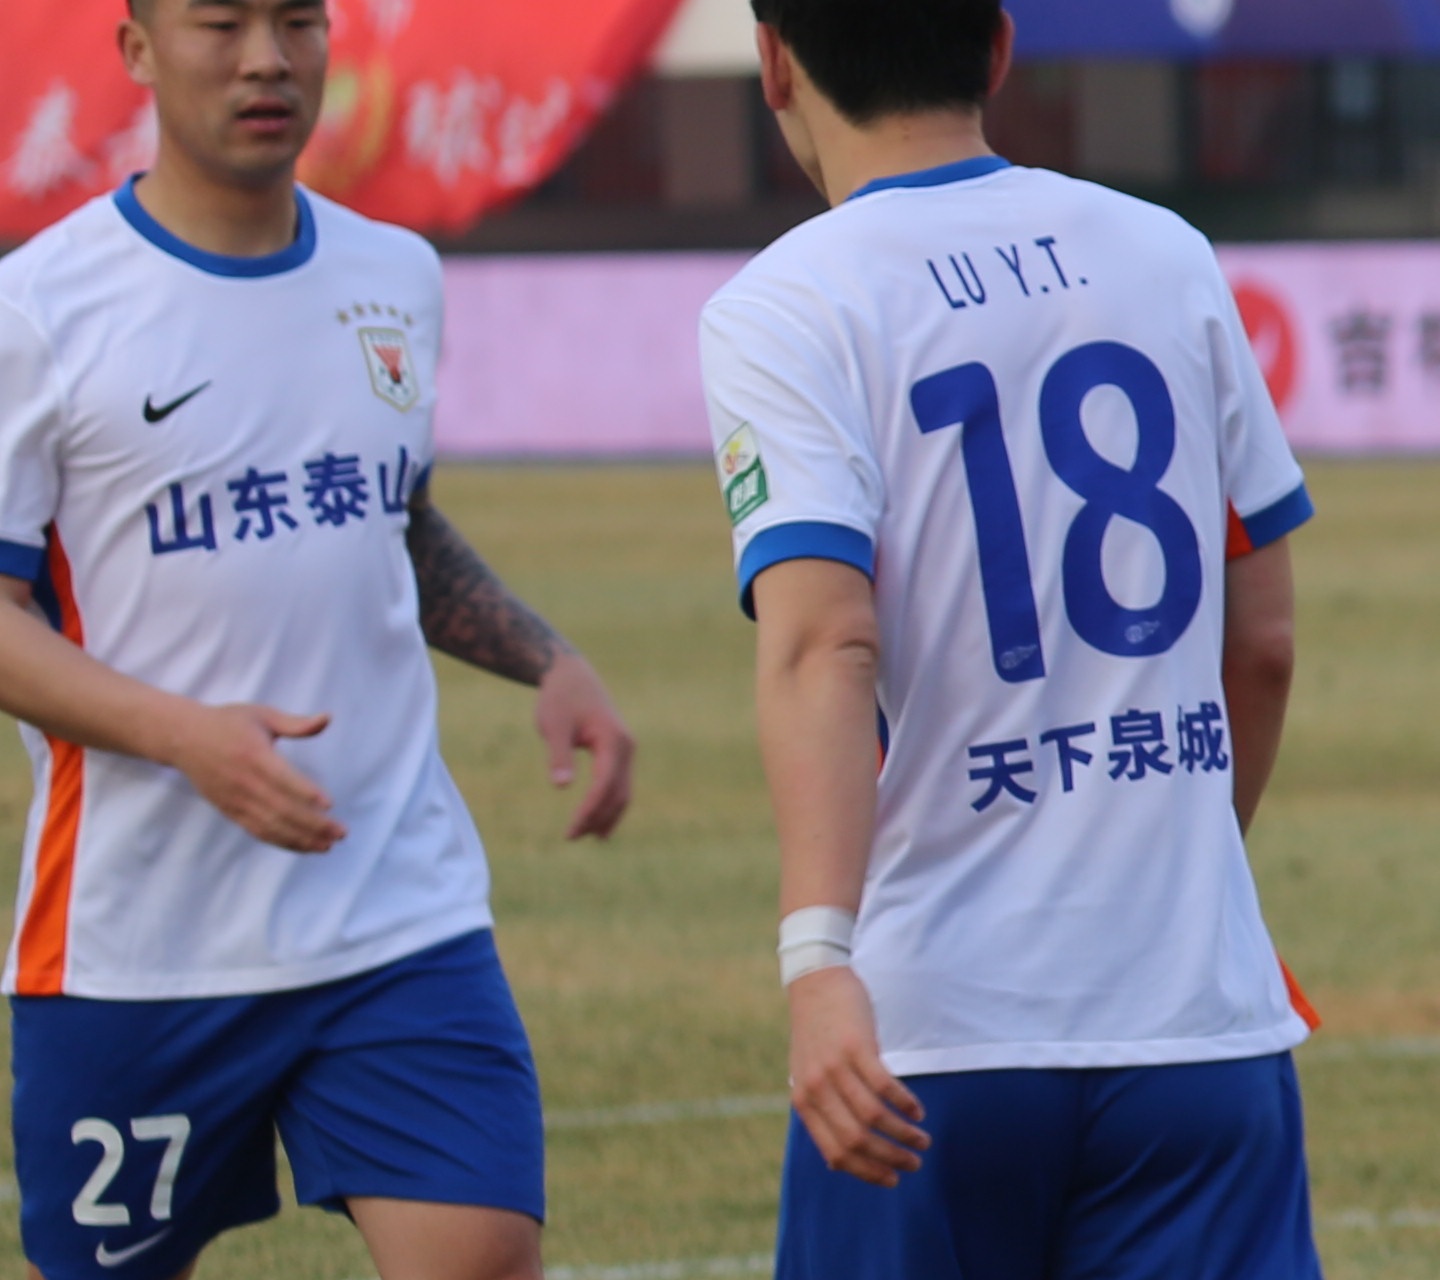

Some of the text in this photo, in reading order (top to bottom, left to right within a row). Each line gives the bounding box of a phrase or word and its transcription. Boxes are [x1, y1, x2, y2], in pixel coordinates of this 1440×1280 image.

[927, 236, 1089, 310] LU Y.T.
[910, 340, 1202, 684] 18
[968, 700, 1230, 813] 天下泉城
[71, 1113, 191, 1226] 27
